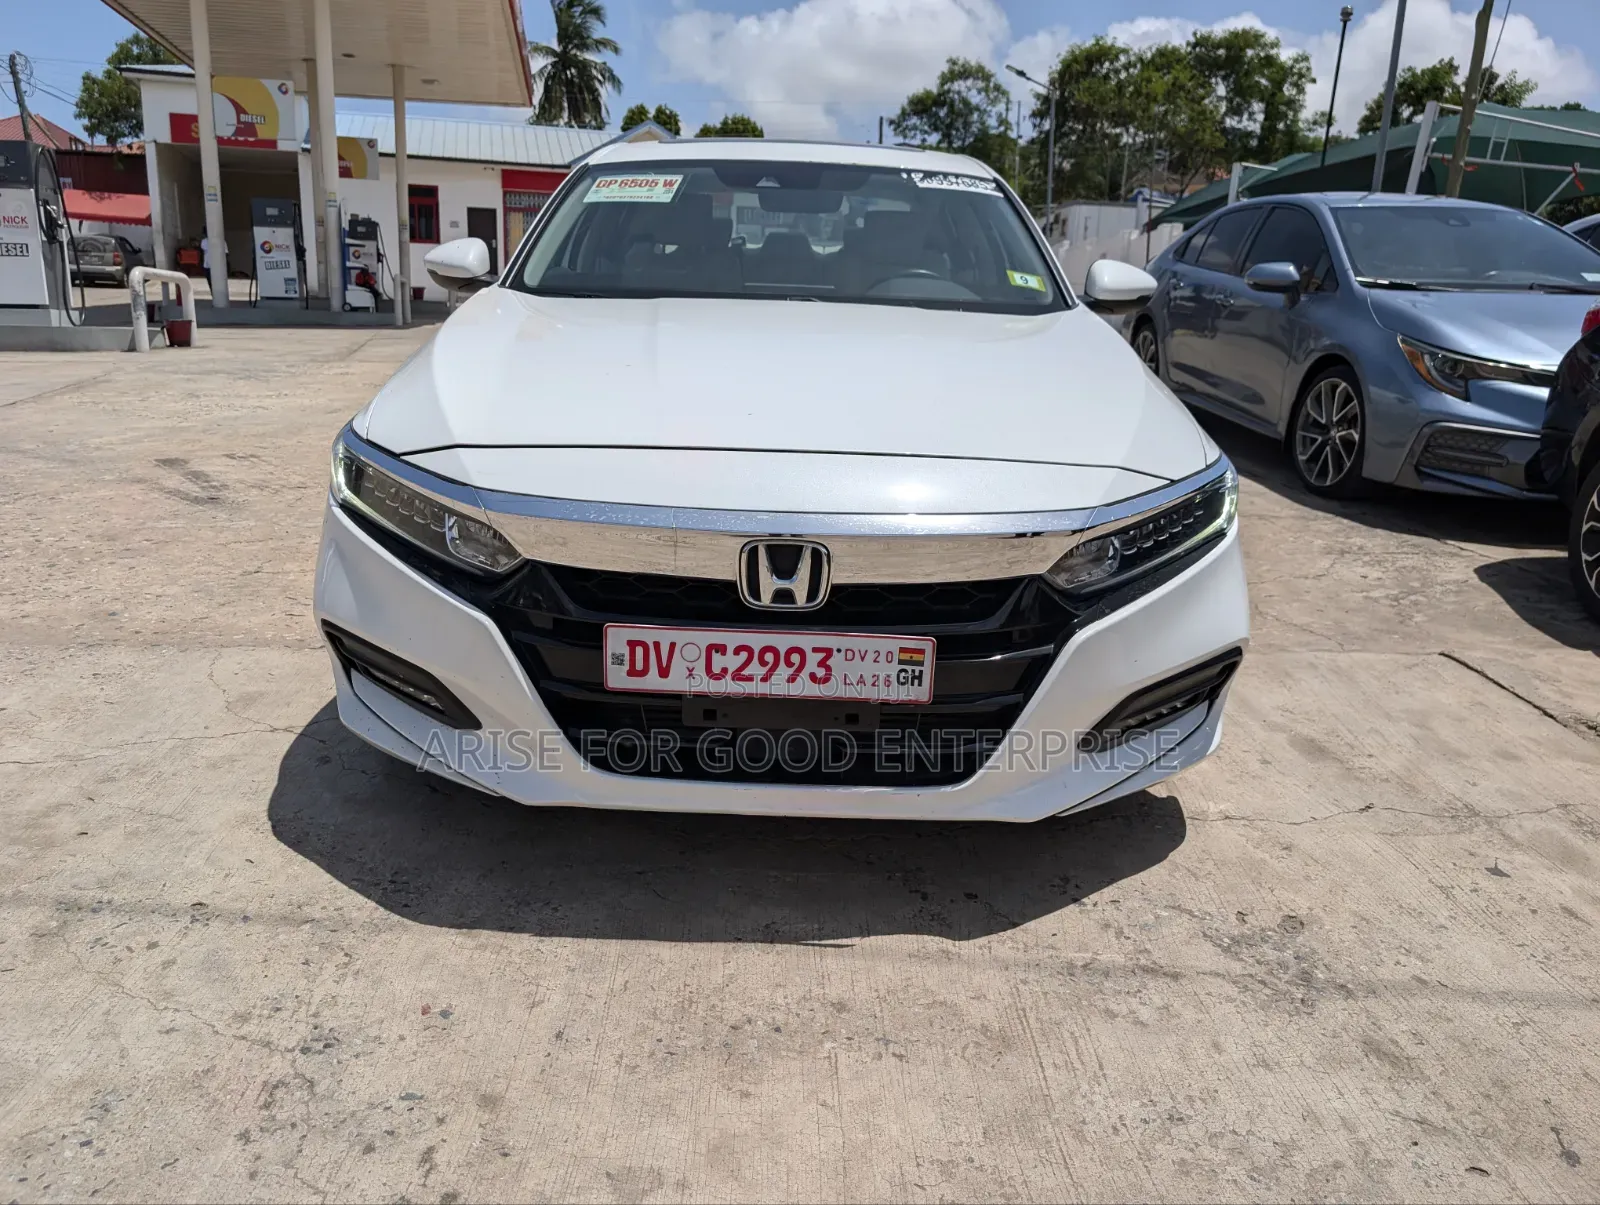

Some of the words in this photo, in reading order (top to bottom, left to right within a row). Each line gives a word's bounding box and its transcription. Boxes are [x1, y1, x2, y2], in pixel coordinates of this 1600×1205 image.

[239, 113, 265, 124] DIESEL
[662, 178, 678, 188] W
[2, 215, 28, 225] NICK
[1020, 275, 1029, 285] 9
[626, 639, 677, 679] DV
[704, 642, 834, 685] C2993
[896, 668, 924, 688] GH
